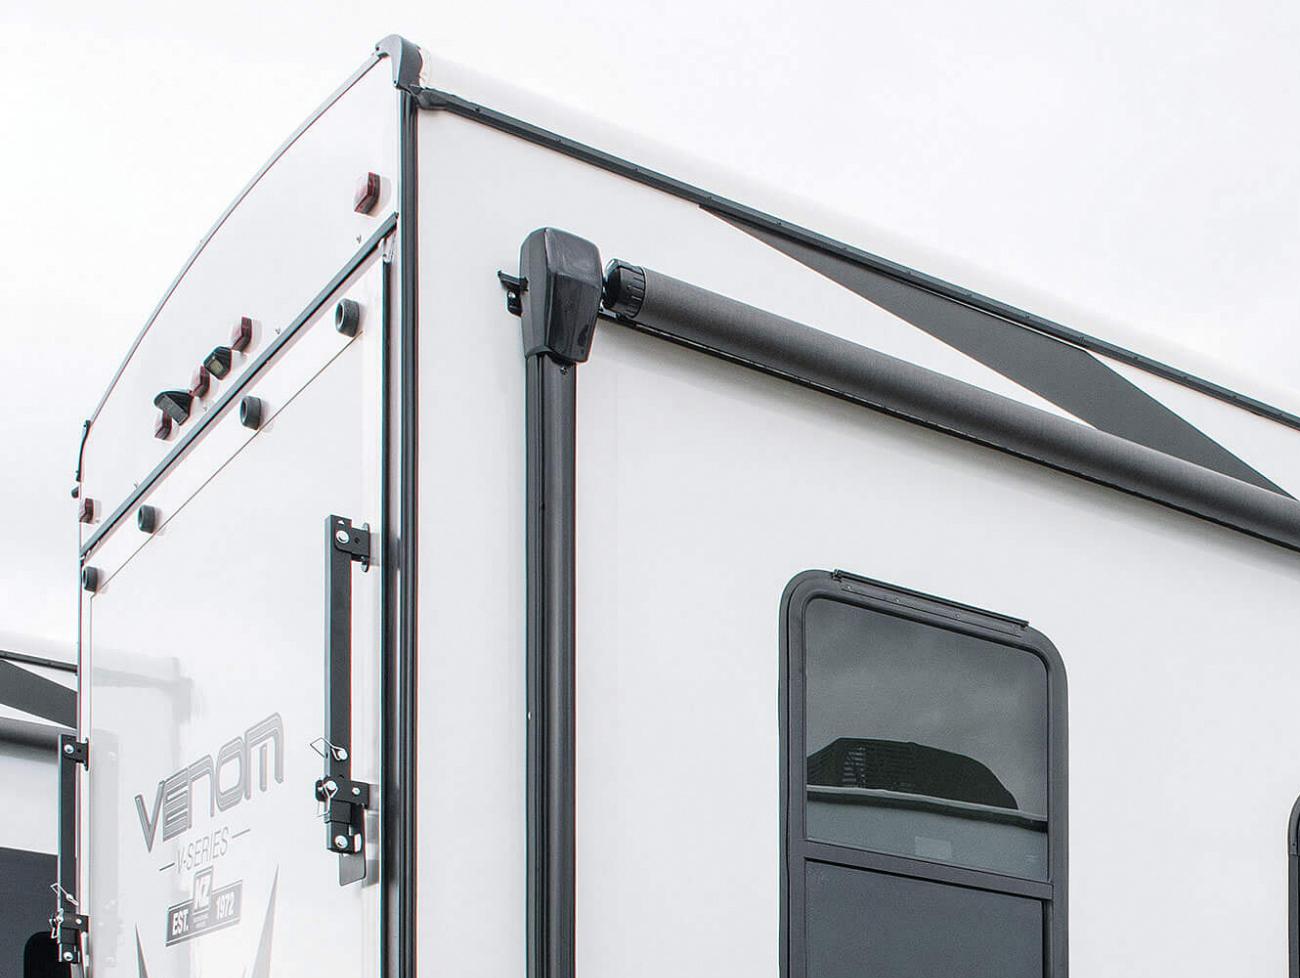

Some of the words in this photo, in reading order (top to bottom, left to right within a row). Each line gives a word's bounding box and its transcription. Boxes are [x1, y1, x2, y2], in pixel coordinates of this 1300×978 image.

[134, 712, 284, 853] VENOM
[175, 827, 230, 874] V-SERIES
[172, 908, 189, 936] EST.
[215, 891, 235, 920] 1972
